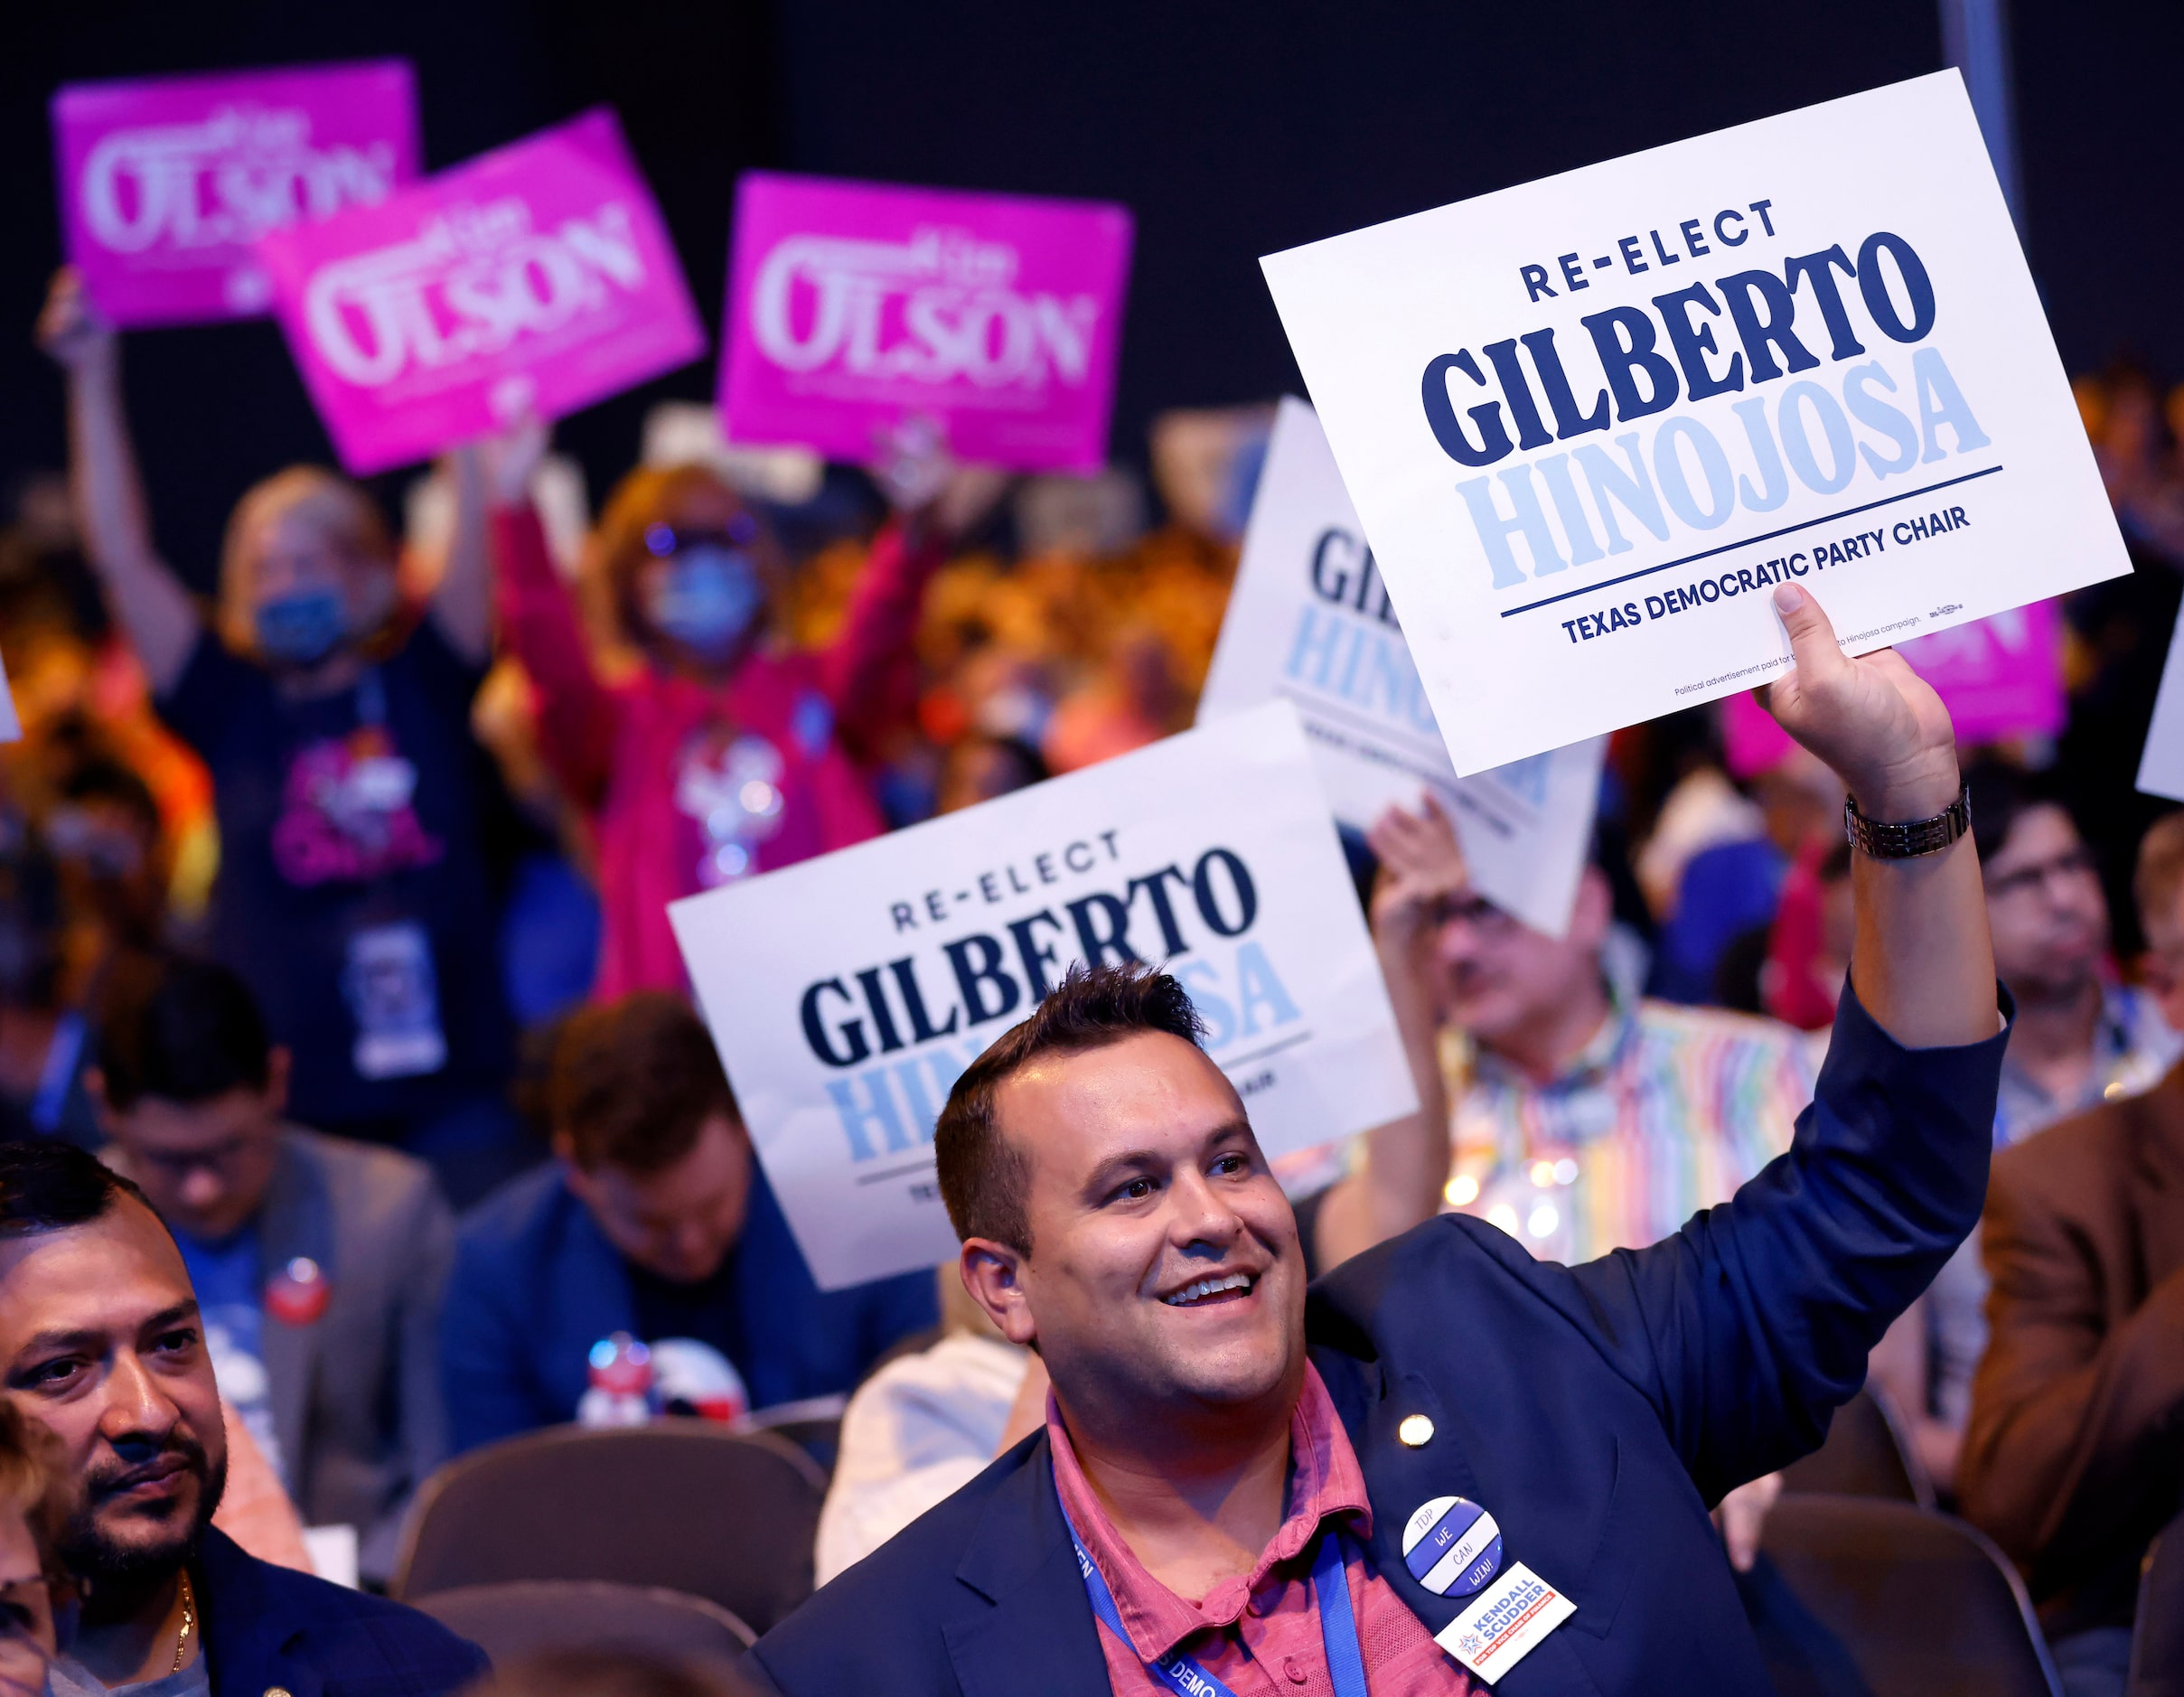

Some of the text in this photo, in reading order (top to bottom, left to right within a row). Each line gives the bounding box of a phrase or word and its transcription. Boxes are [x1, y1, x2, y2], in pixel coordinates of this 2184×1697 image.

[1519, 198, 1777, 302] RE-ELECT
[304, 203, 647, 387] OLSON
[754, 233, 1096, 389] OLSON
[1421, 231, 1936, 467] GILBERTO
[1456, 346, 1992, 590] HINOJOSA
[1561, 505, 1971, 644] TEXAS DEMOCRATIC PARTY CHAIR
[1846, 626, 1880, 645] Hinojosa
[1880, 615, 1922, 636] campaign.
[1674, 680, 1705, 697] Political
[1706, 664, 1760, 688] advertisement
[1761, 658, 1779, 673] paid
[1779, 655, 1791, 664] for
[890, 830, 1120, 933] RE-ELECT
[801, 848, 1259, 1068] GILBERTO
[1414, 1508, 1434, 1531] TDP
[1435, 1526, 1453, 1547] WE
[1453, 1542, 1474, 1565] CAN
[1468, 1558, 1494, 1587] WIN!
[1473, 1579, 1534, 1632] KENDALL
[1483, 1585, 1546, 1641] SCUDDER
[1495, 1633, 1510, 1645] VICE
[1507, 1619, 1524, 1636] CHAIR
[1522, 1612, 1532, 1622] OF
[1530, 1594, 1553, 1615] FINANCE
